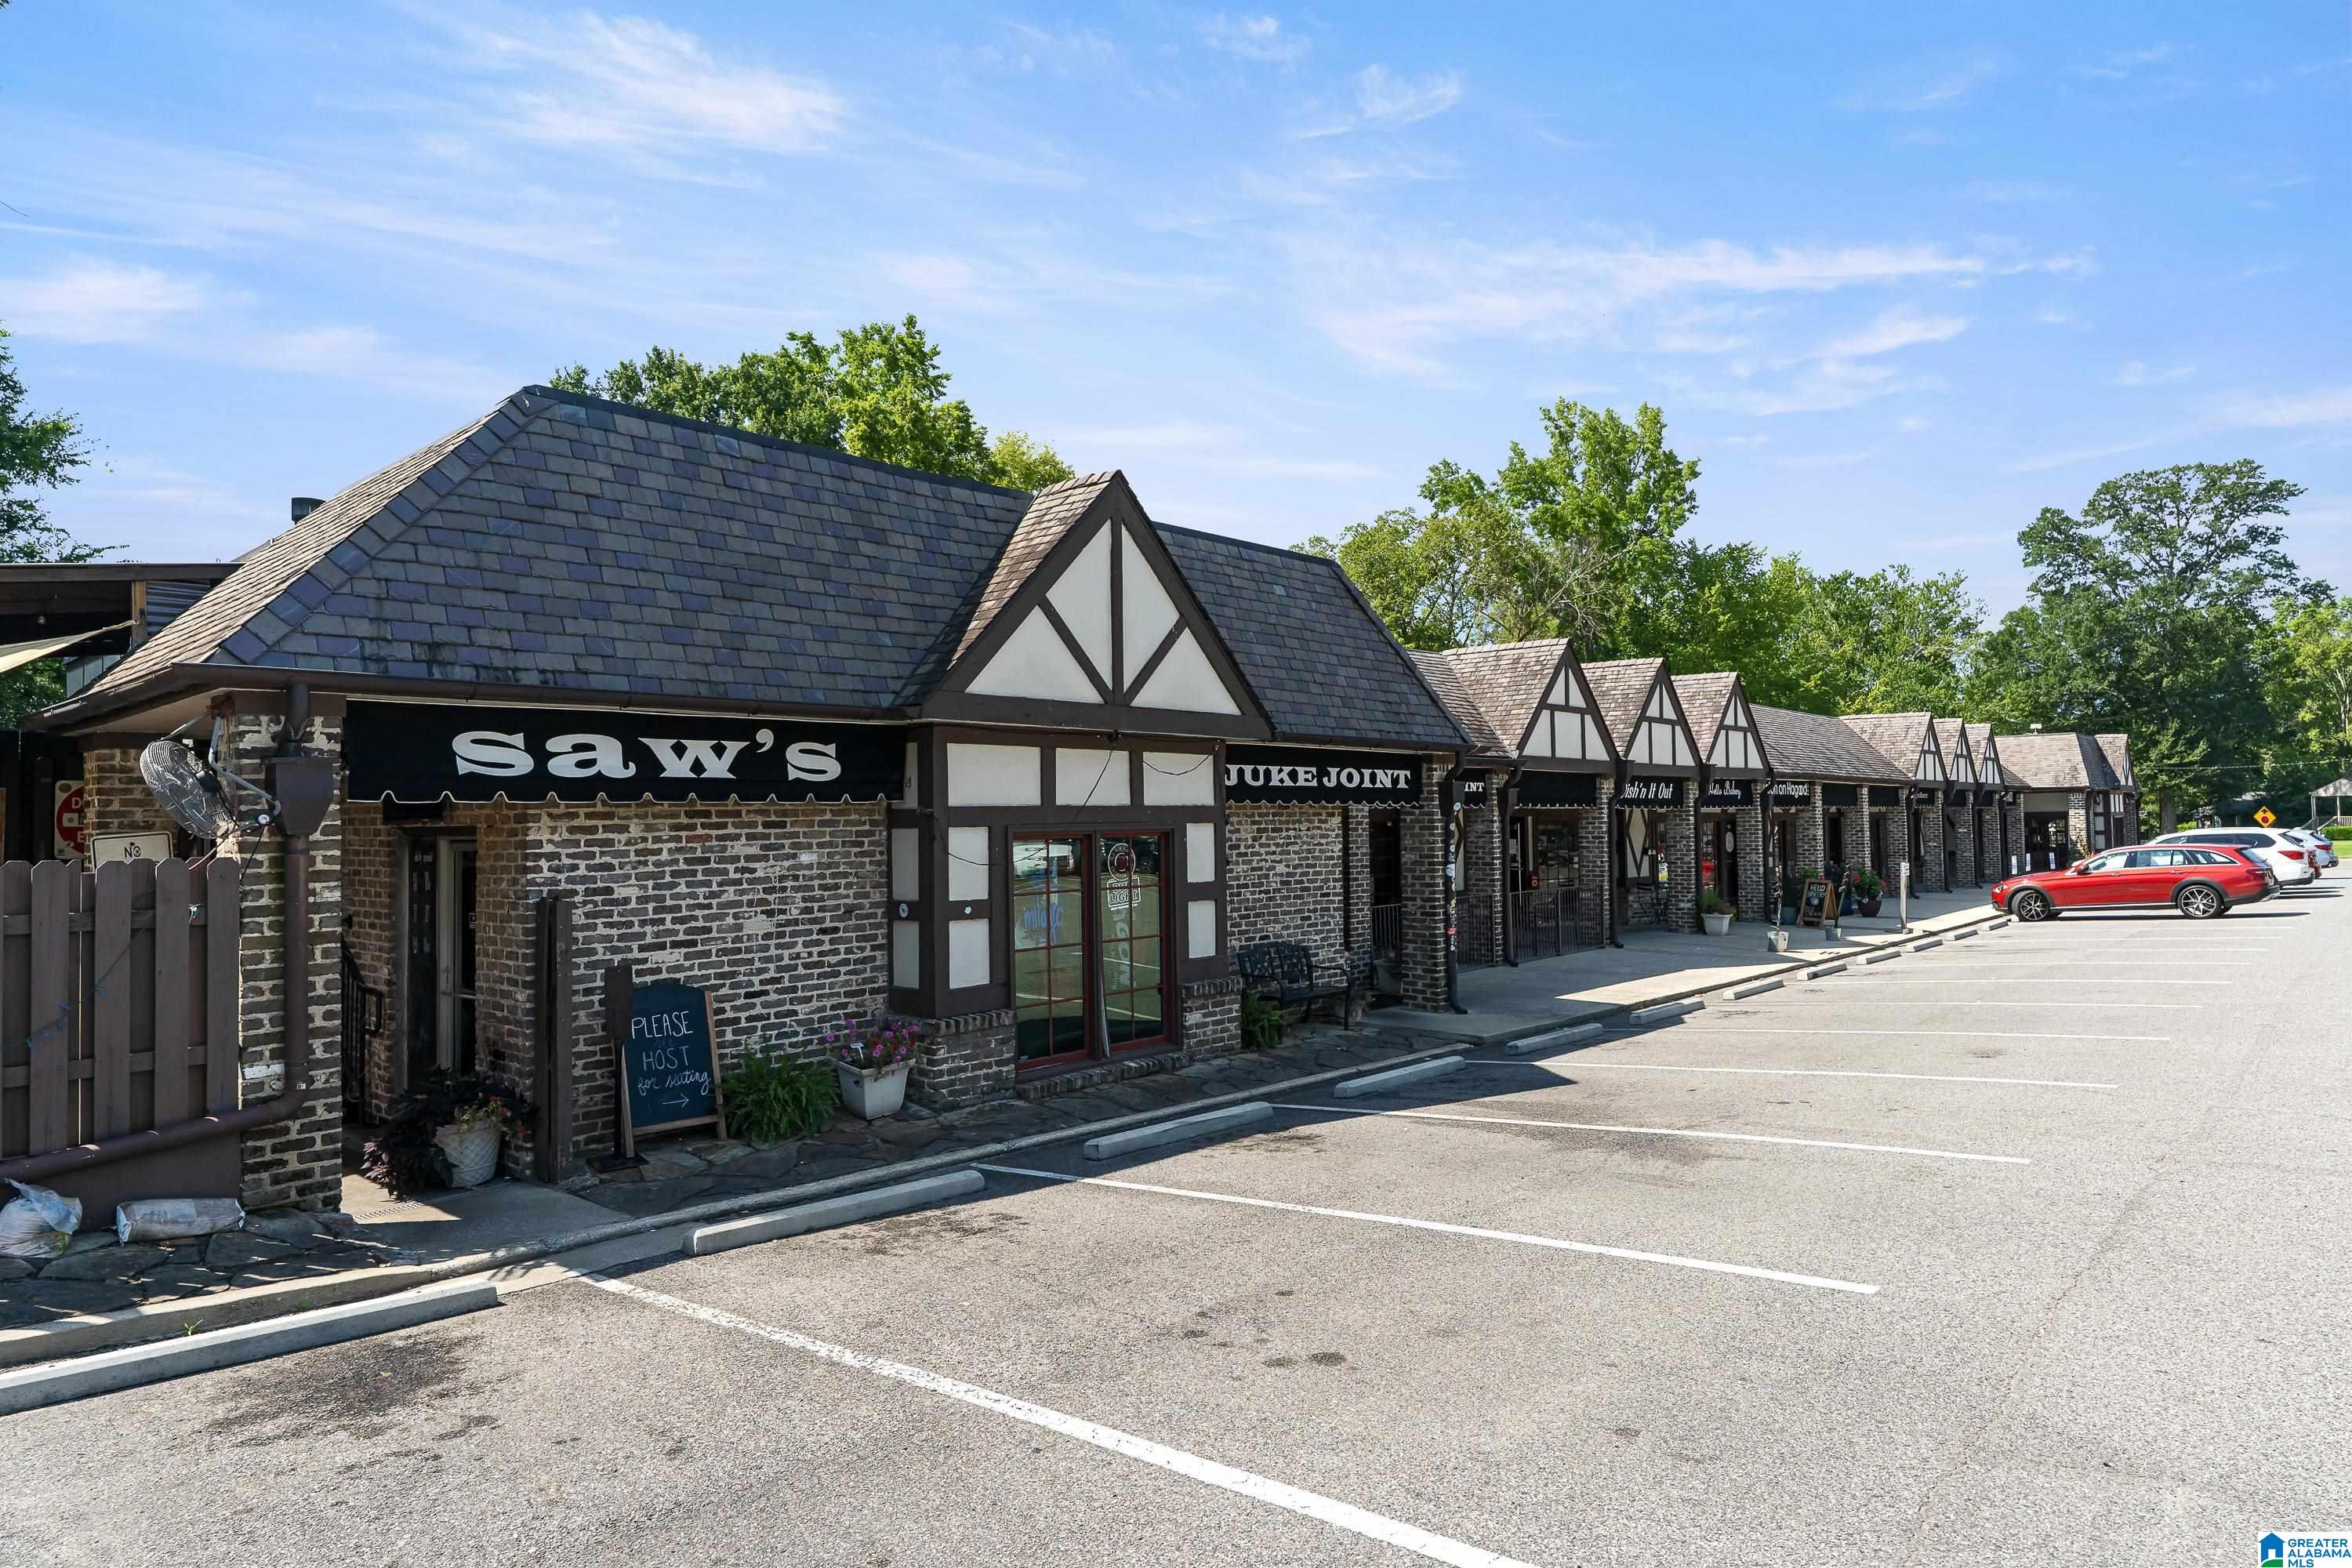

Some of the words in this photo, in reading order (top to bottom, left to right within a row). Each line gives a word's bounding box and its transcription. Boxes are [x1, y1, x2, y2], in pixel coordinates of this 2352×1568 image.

[1225, 764, 1317, 786] JUKE
[1323, 767, 1411, 789] JOINT
[1648, 782, 1657, 799] It
[1657, 782, 1673, 799] Out
[1778, 784, 1787, 795] on
[124, 847, 141, 858] NO
[631, 1011, 694, 1040] PLEASE
[642, 1045, 690, 1071] HOST
[638, 1076, 659, 1096] for
[666, 1069, 710, 1095] seating
